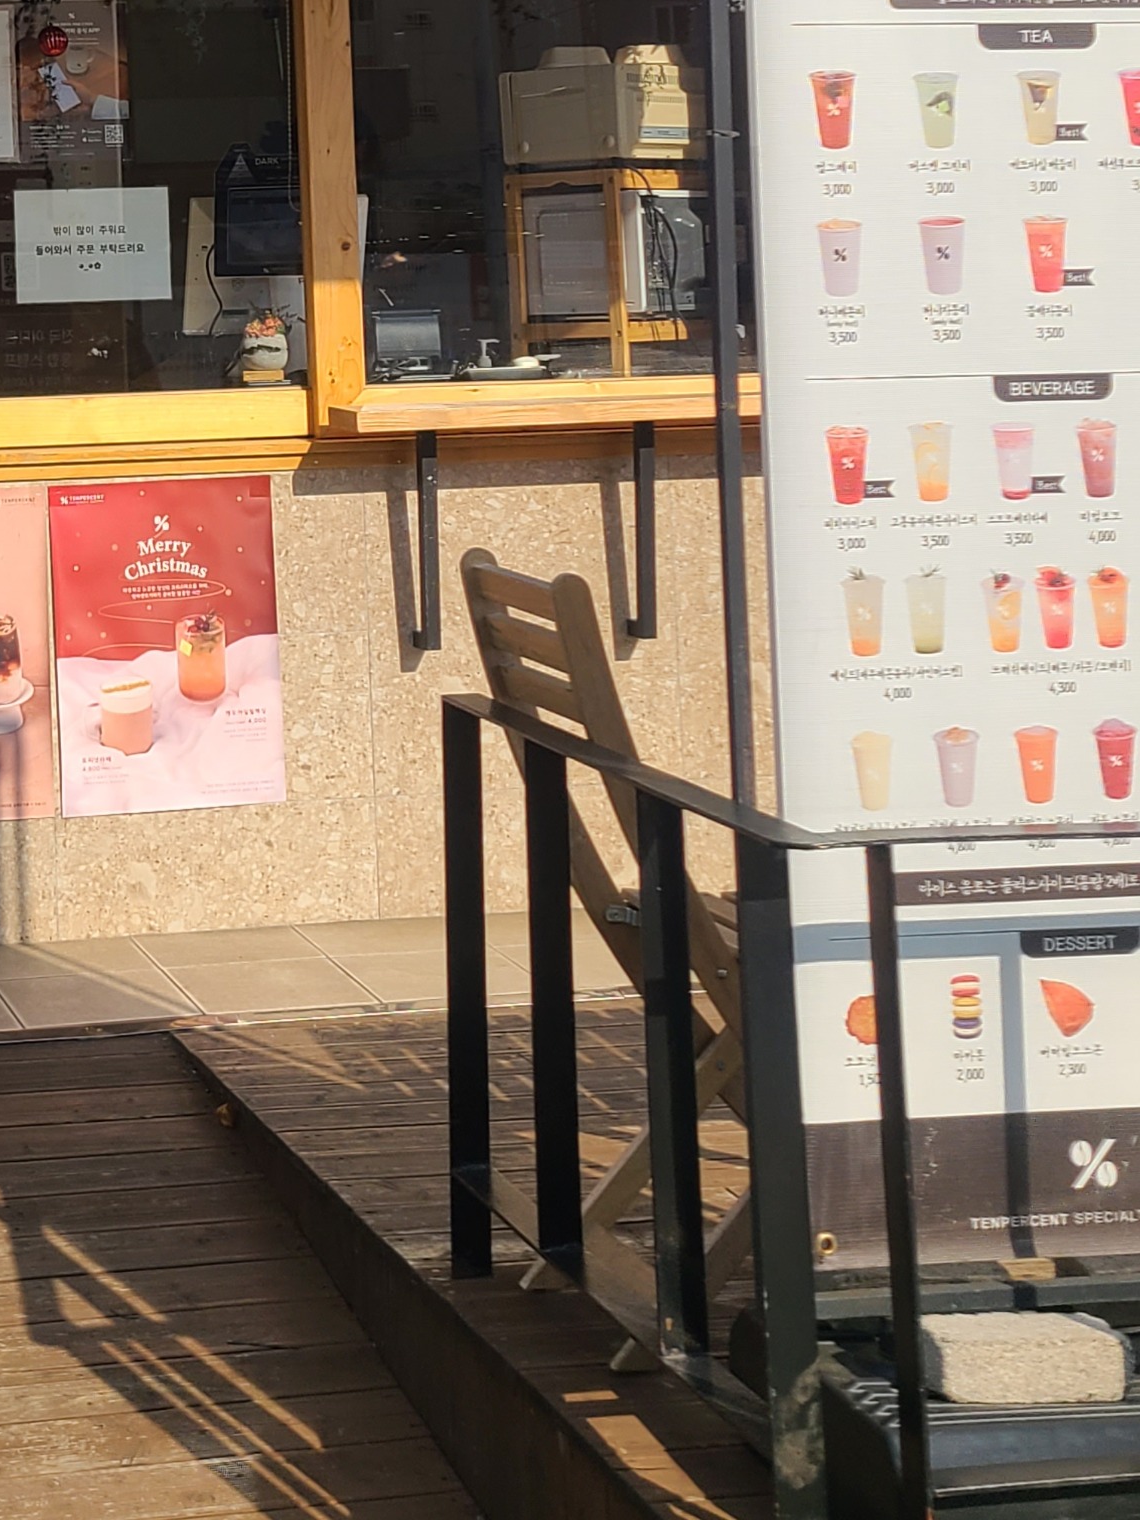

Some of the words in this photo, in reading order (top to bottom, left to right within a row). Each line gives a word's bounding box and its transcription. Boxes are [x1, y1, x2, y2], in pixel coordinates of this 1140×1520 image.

[1019, 29, 1054, 43] TEA
[822, 183, 853, 198] 3,000
[925, 181, 956, 196] 3,000
[1029, 180, 1059, 195] 3,000
[1008, 380, 1096, 396] BEVERAGE
[836, 537, 867, 552] 3,000
[1087, 529, 1117, 545] 4,000
[137, 539, 192, 558] Merry
[124, 557, 208, 581] Christmas
[883, 687, 913, 702] 4,000
[1042, 934, 1117, 952] DESSERT
[956, 1068, 986, 1083] 2,000
[969, 1212, 1070, 1230] TENPERCENT
